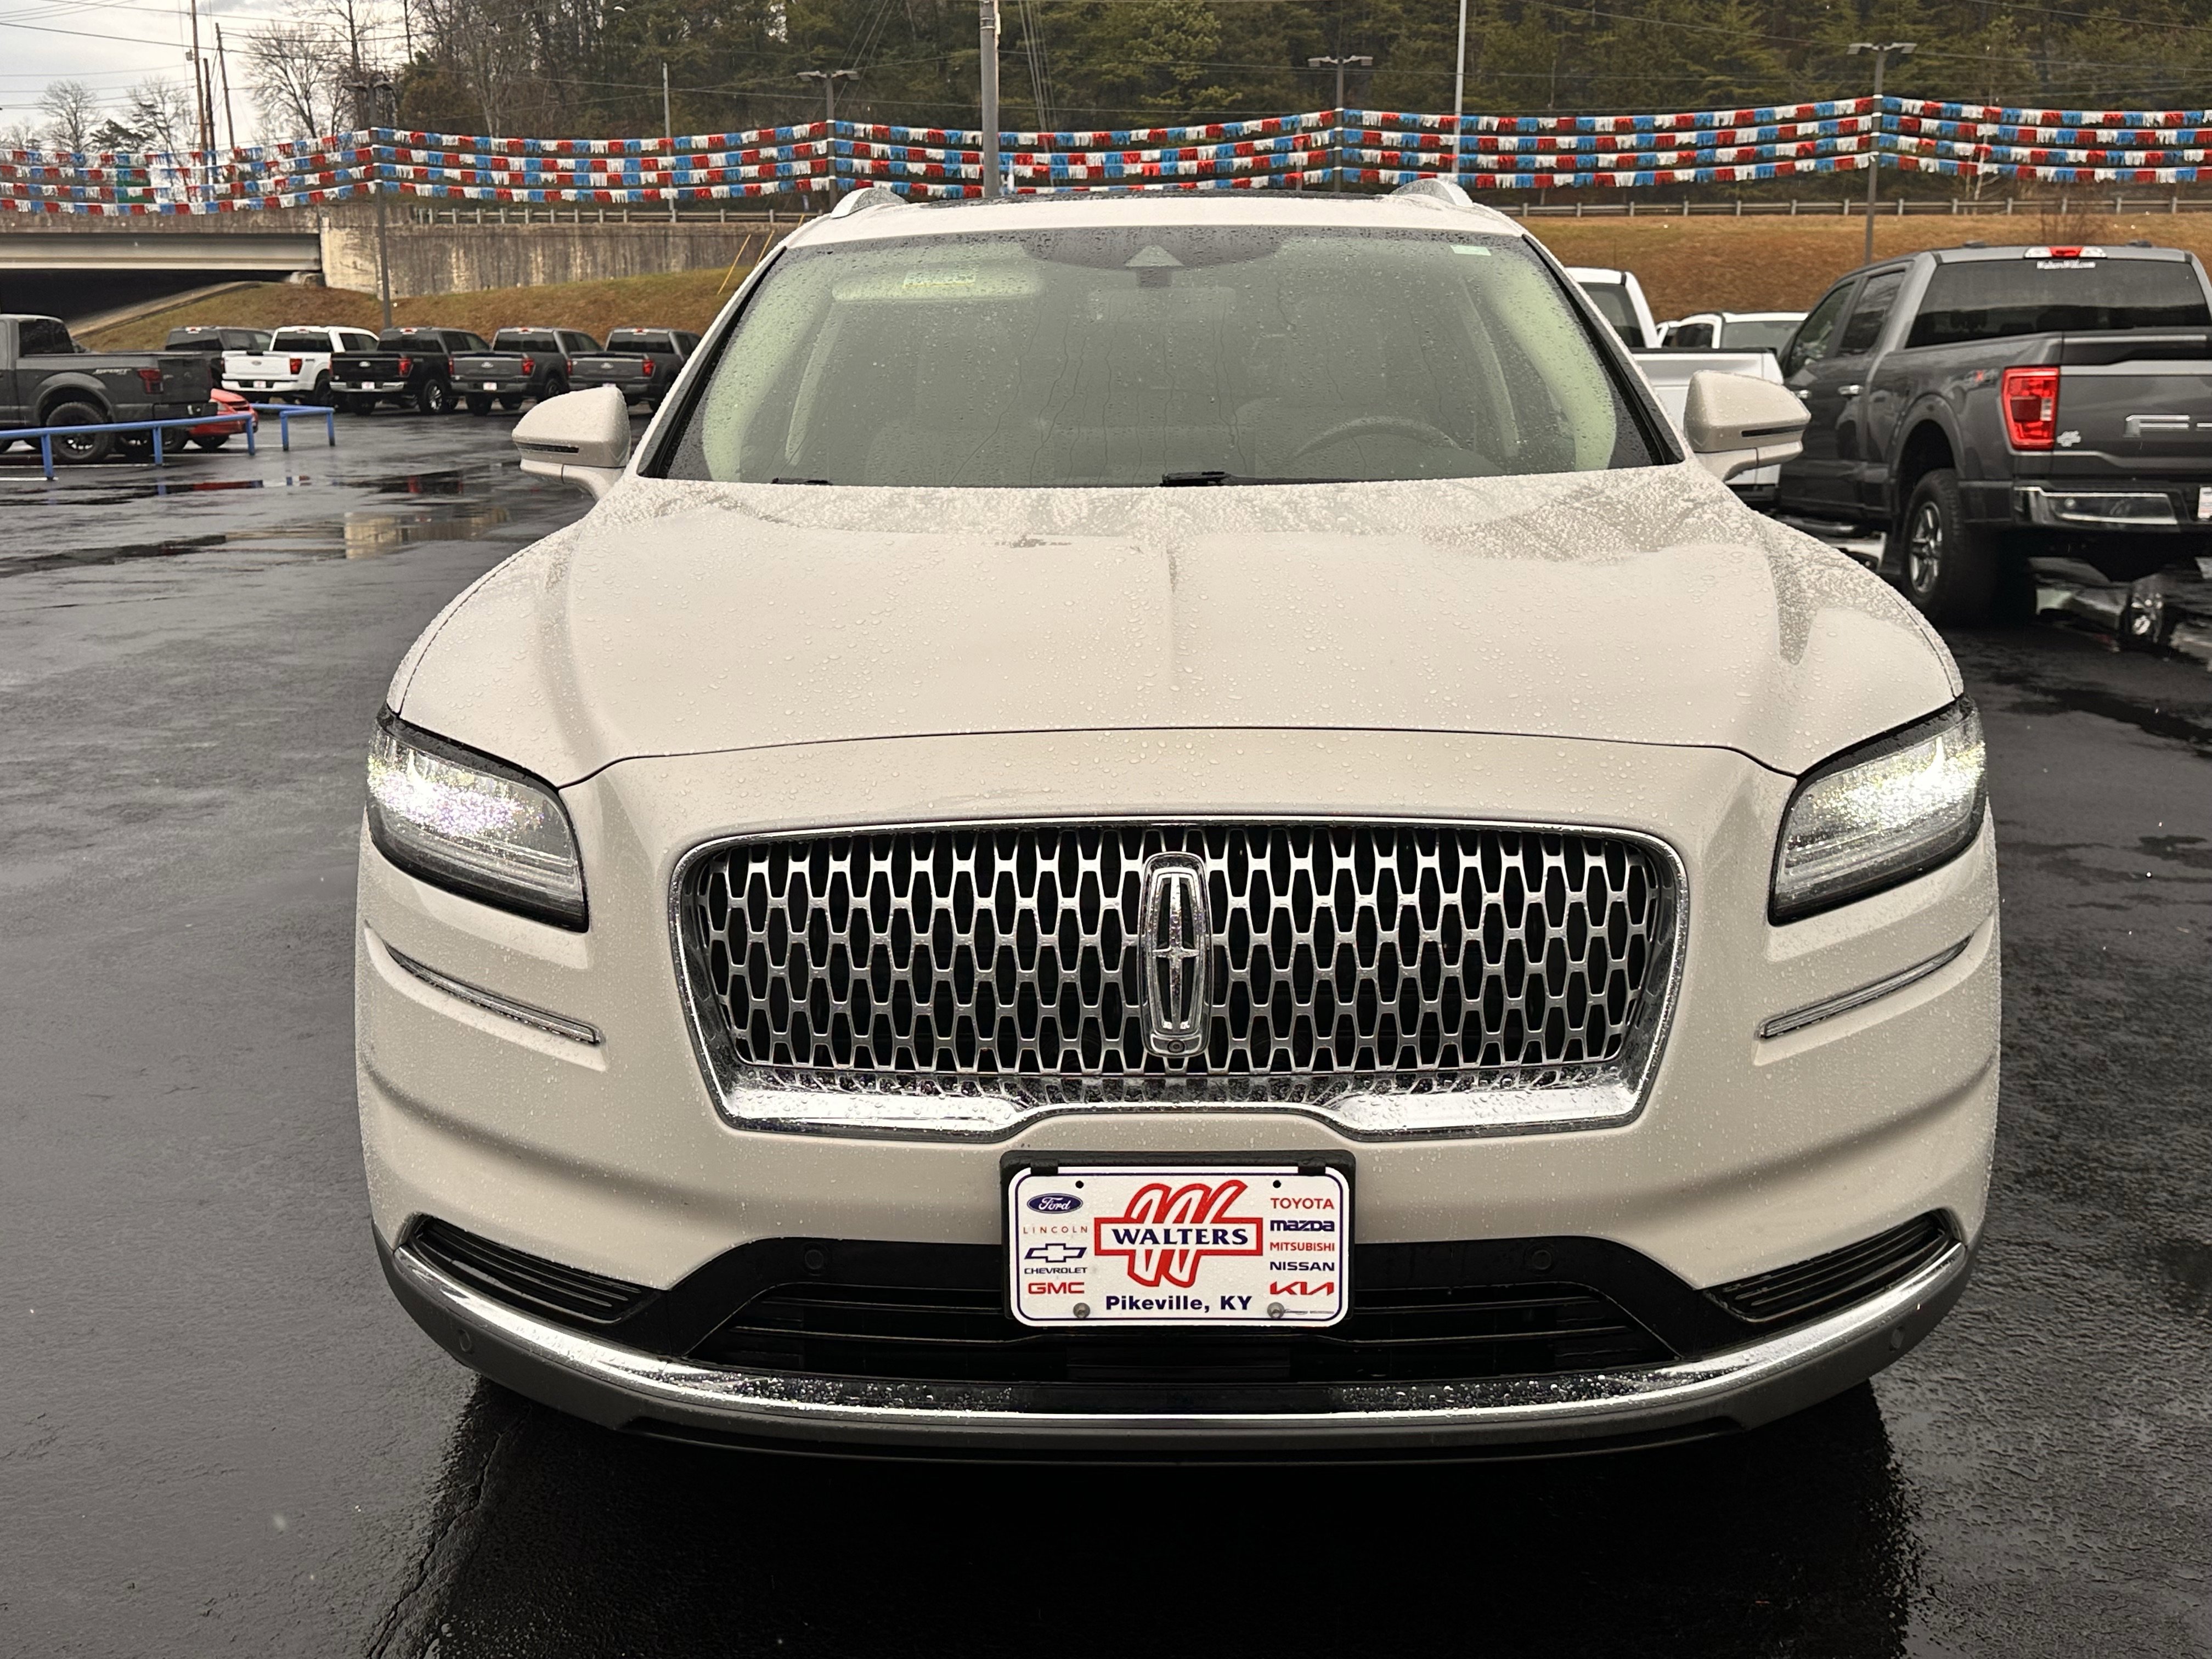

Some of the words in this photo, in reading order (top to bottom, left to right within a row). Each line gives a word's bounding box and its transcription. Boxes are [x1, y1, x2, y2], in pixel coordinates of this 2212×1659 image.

[1038, 1197, 1071, 1210] Ford
[1270, 1198, 1335, 1210] TOYOTA
[1023, 1226, 1088, 1234] LINCOLN
[1111, 1228, 1248, 1245] WALTERS
[1269, 1242, 1335, 1251] MITSUBISHI
[1269, 1261, 1335, 1271] NISSAN
[1028, 1282, 1085, 1294] GMC
[1269, 1281, 1334, 1296] KIA
[1106, 1295, 1210, 1313] Pikeville,
[1220, 1295, 1252, 1311] KY
